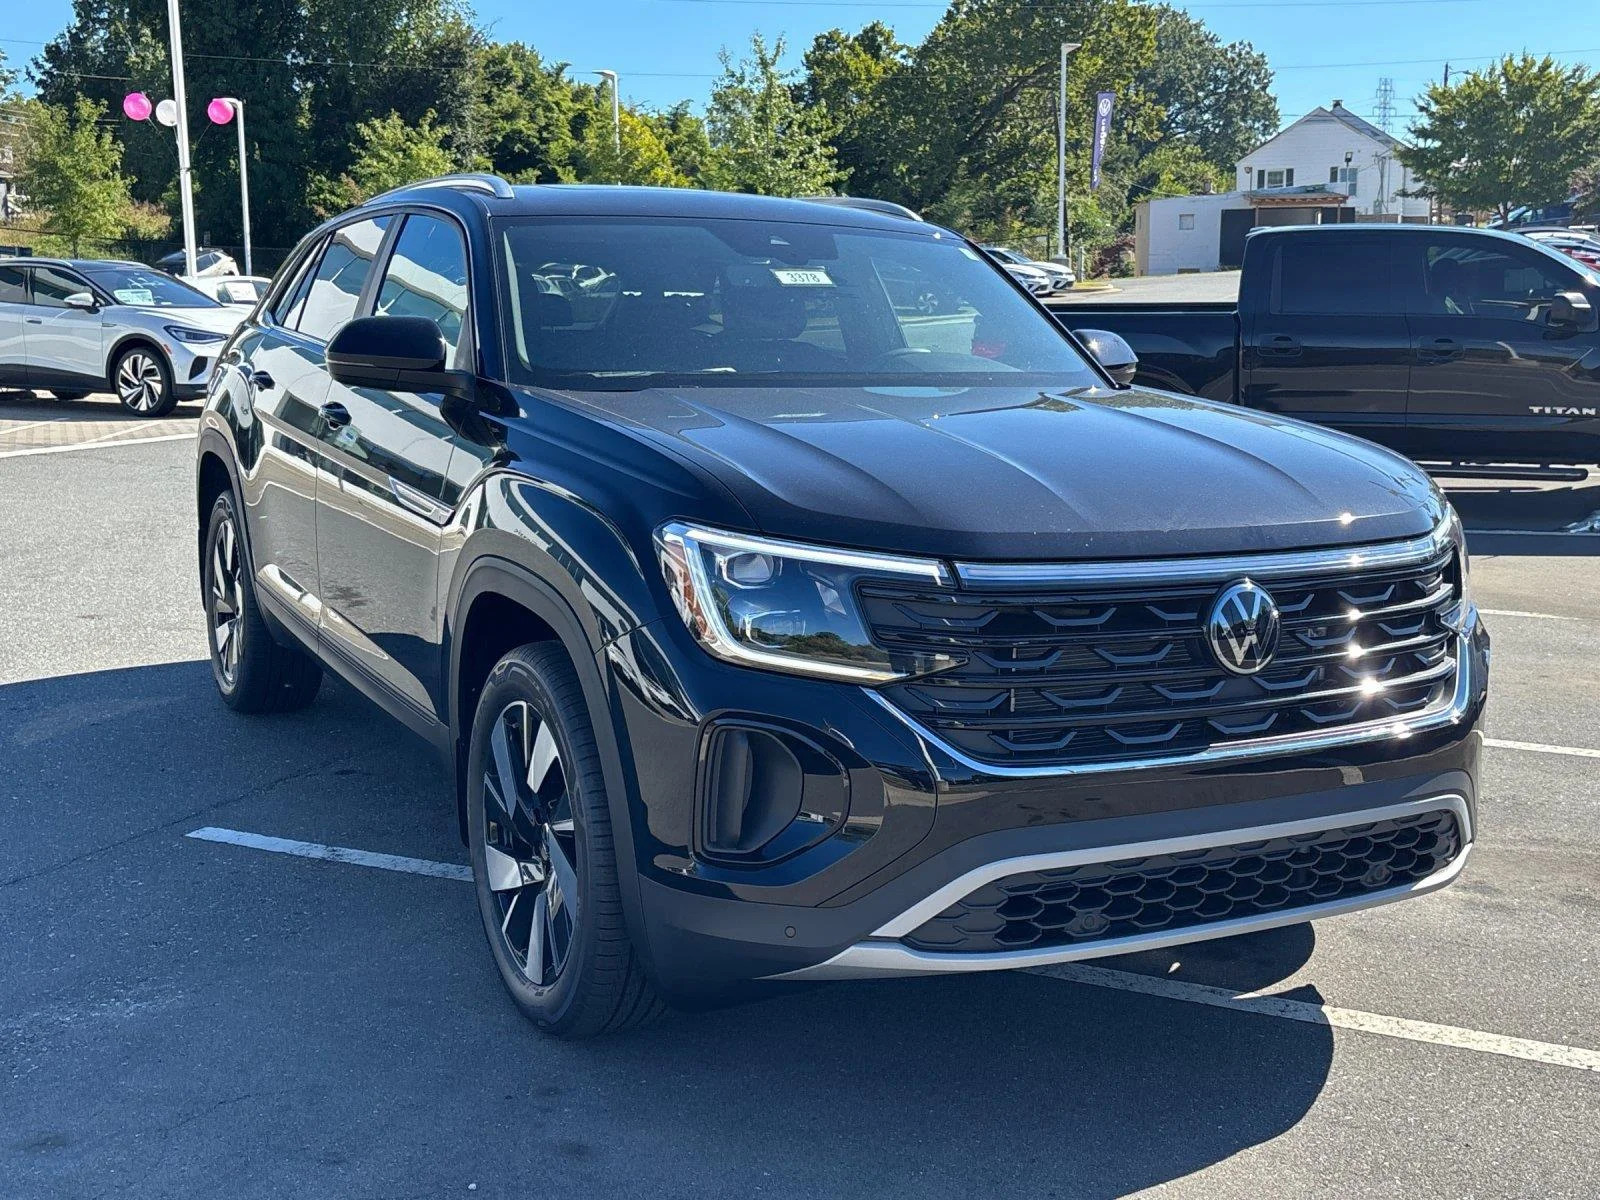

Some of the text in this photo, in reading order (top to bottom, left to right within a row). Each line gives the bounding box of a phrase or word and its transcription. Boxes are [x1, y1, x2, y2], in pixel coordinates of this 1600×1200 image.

[1093, 118, 1107, 182] Vowagen
[786, 272, 821, 283] 3378
[1528, 406, 1597, 416] TITAN
